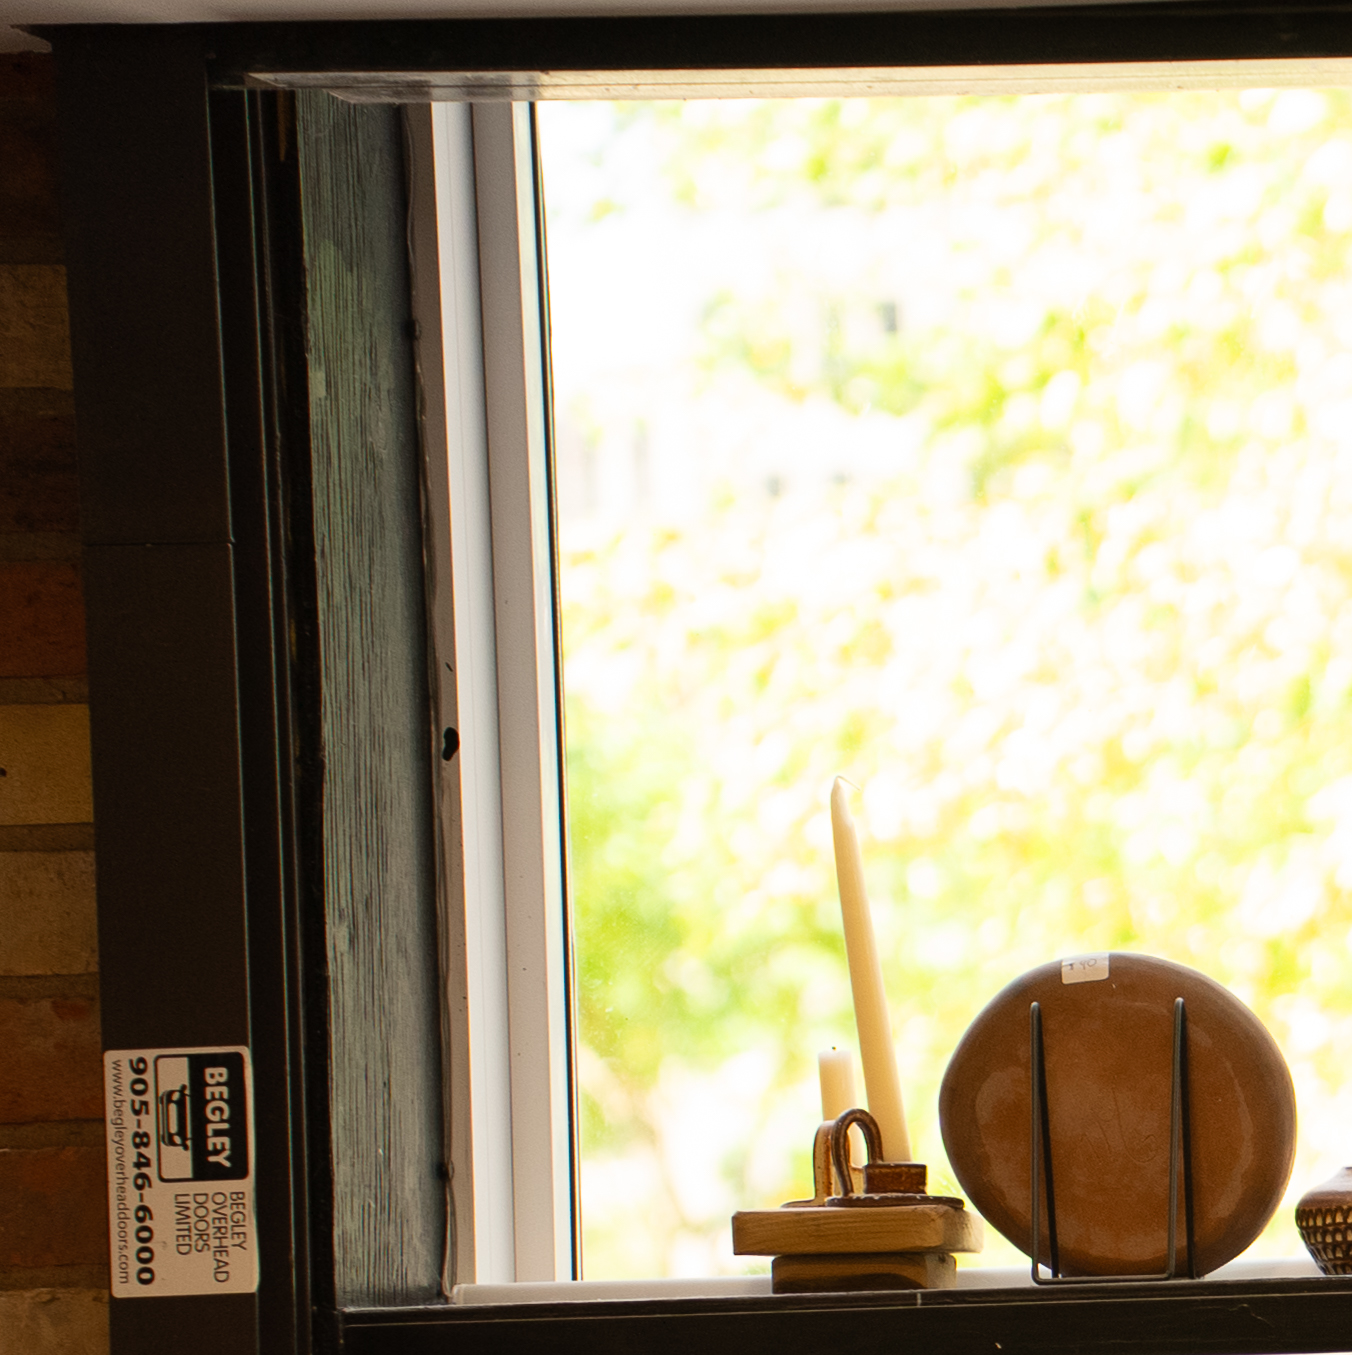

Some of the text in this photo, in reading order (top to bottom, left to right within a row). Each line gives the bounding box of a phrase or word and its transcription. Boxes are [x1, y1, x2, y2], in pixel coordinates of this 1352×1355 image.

[203, 1066, 231, 1168] BEGLEY
[110, 1059, 130, 1285] www.begleyoverheaddoors.com
[128, 1056, 156, 1286] 905-846-6000
[174, 1193, 192, 1256] LIMITED
[193, 1192, 210, 1254] DOORS
[211, 1191, 230, 1283] OVERHEAD
[229, 1191, 247, 1251] BEGLEY
